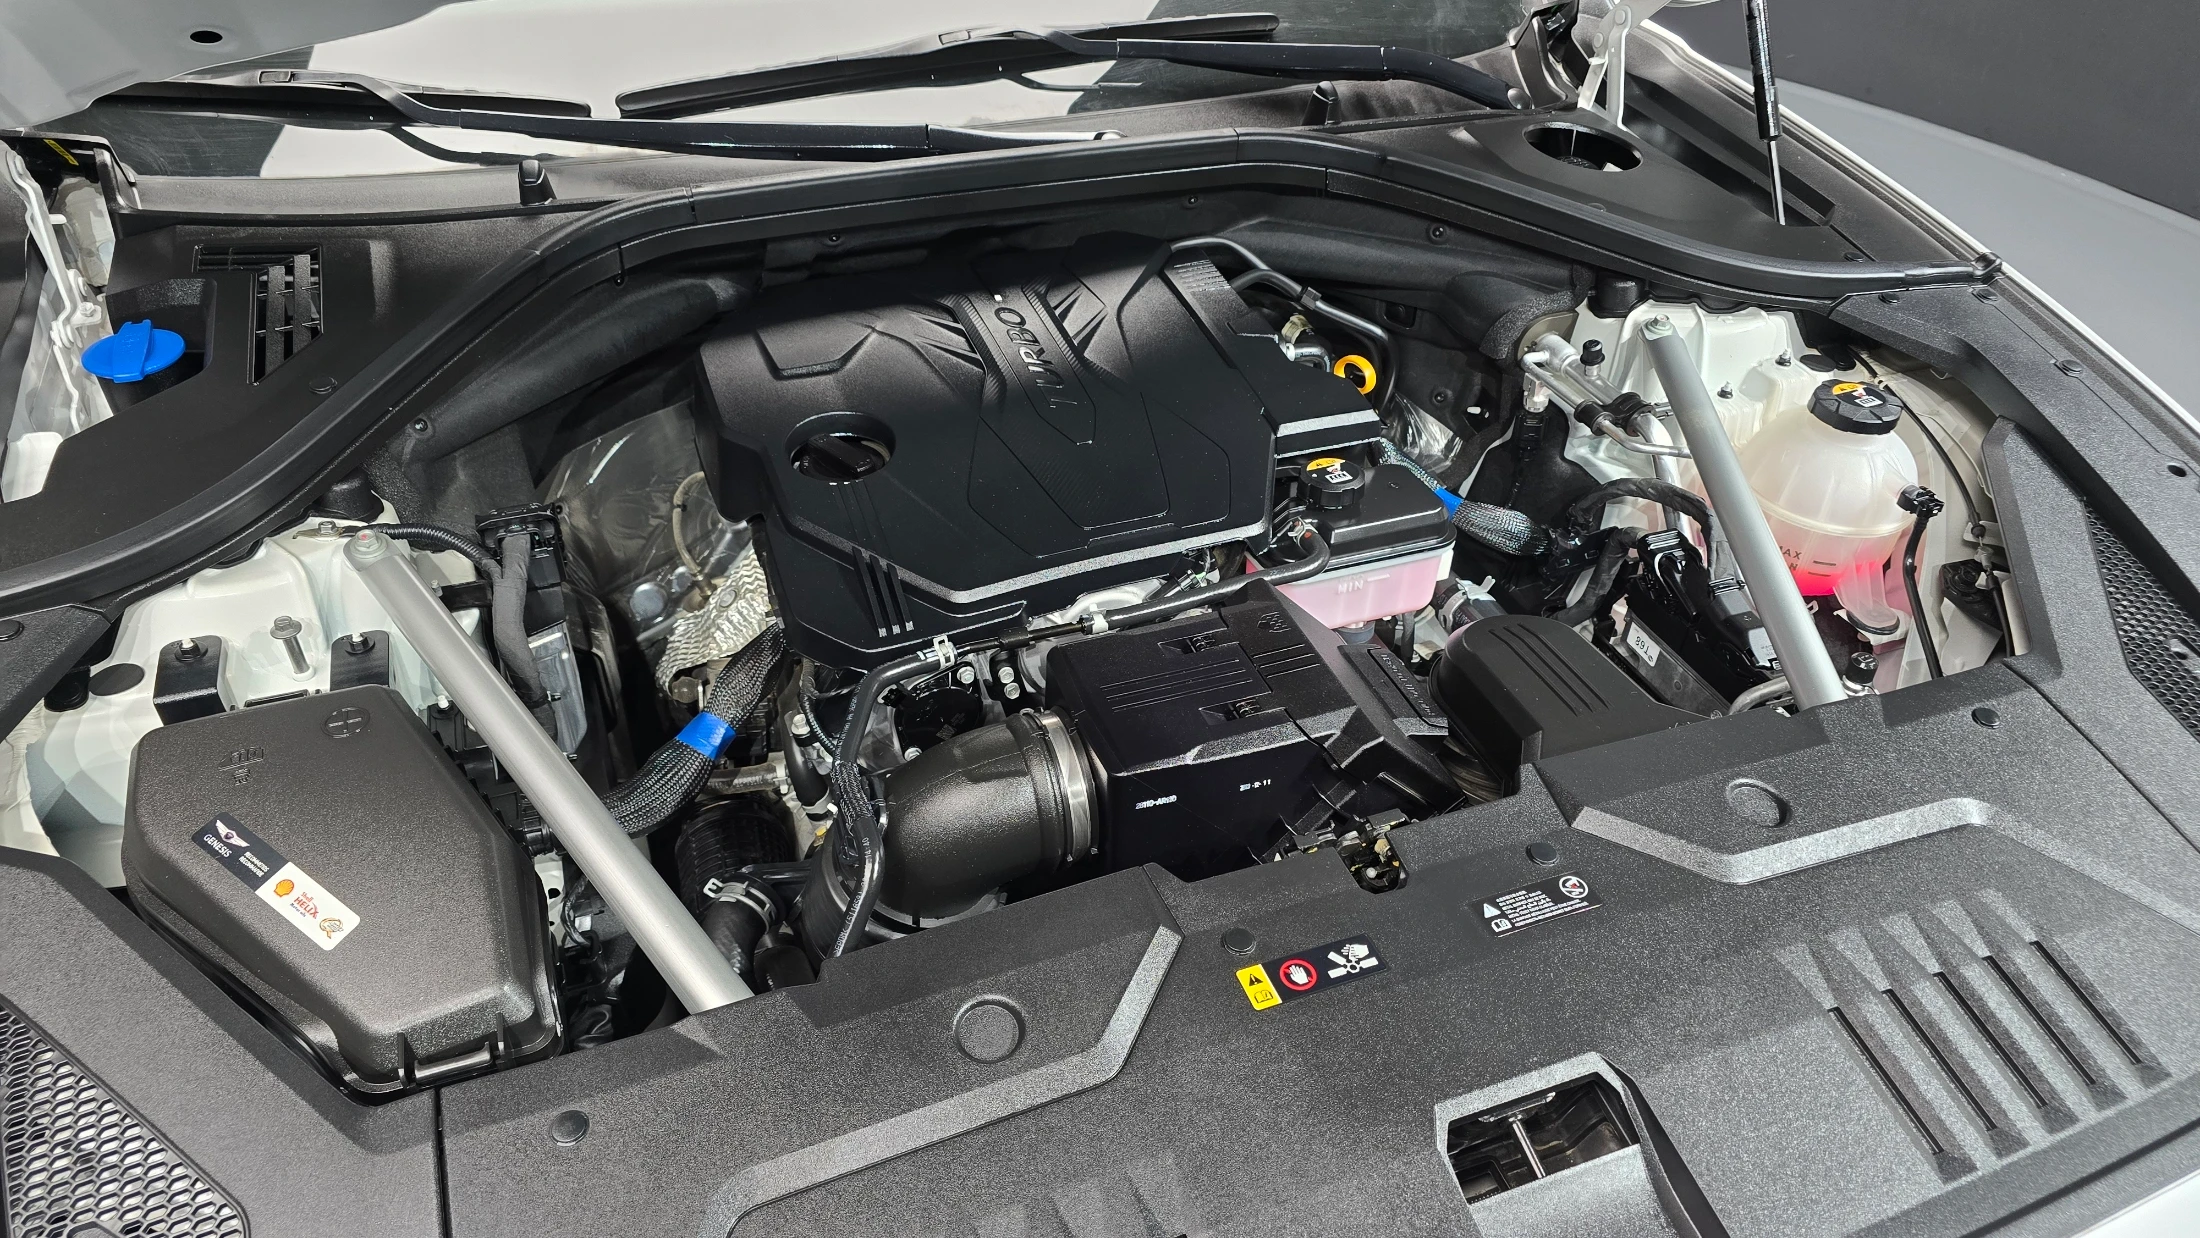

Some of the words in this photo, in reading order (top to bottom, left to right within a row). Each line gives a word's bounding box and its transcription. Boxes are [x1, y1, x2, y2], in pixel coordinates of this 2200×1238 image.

[994, 306, 1077, 408] TURBO
[1338, 580, 1363, 593] MIN
[1635, 636, 1650, 655] T68
[204, 834, 232, 857] GENESIS
[301, 892, 313, 902] Shell
[294, 898, 319, 919] HELIX
